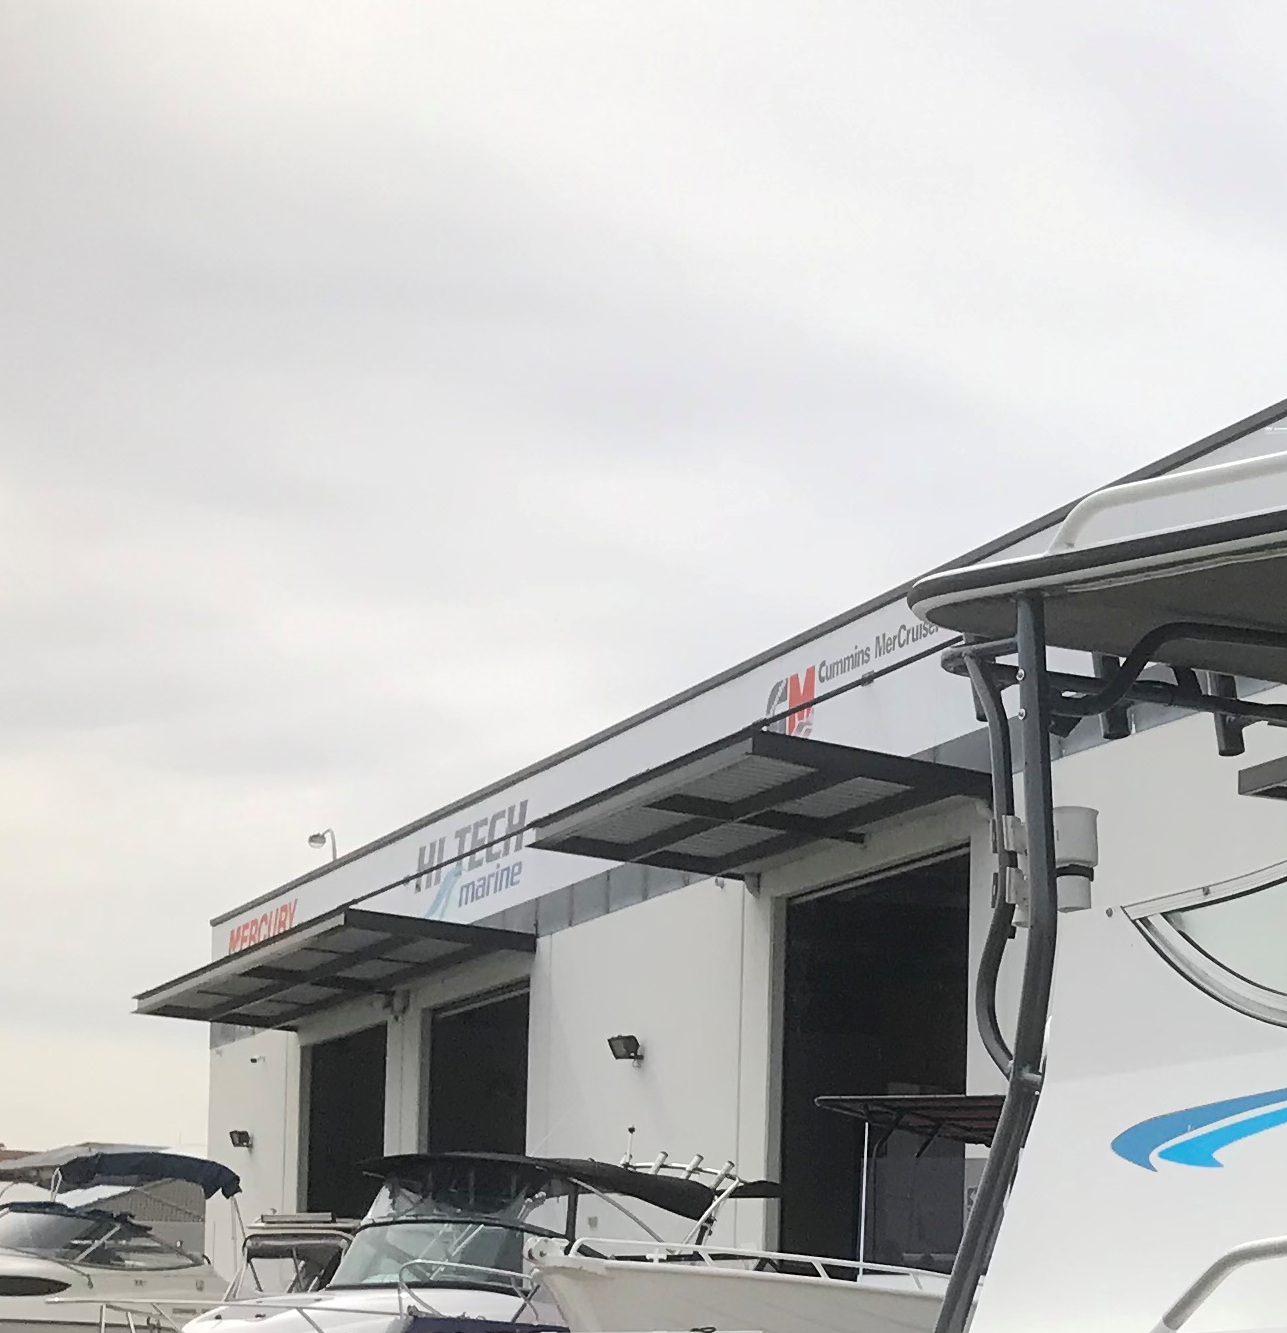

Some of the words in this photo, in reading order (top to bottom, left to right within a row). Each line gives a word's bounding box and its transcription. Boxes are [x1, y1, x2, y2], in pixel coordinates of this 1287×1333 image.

[818, 645, 871, 684] Cummins
[455, 799, 529, 872] TECH
[459, 861, 522, 908] marine
